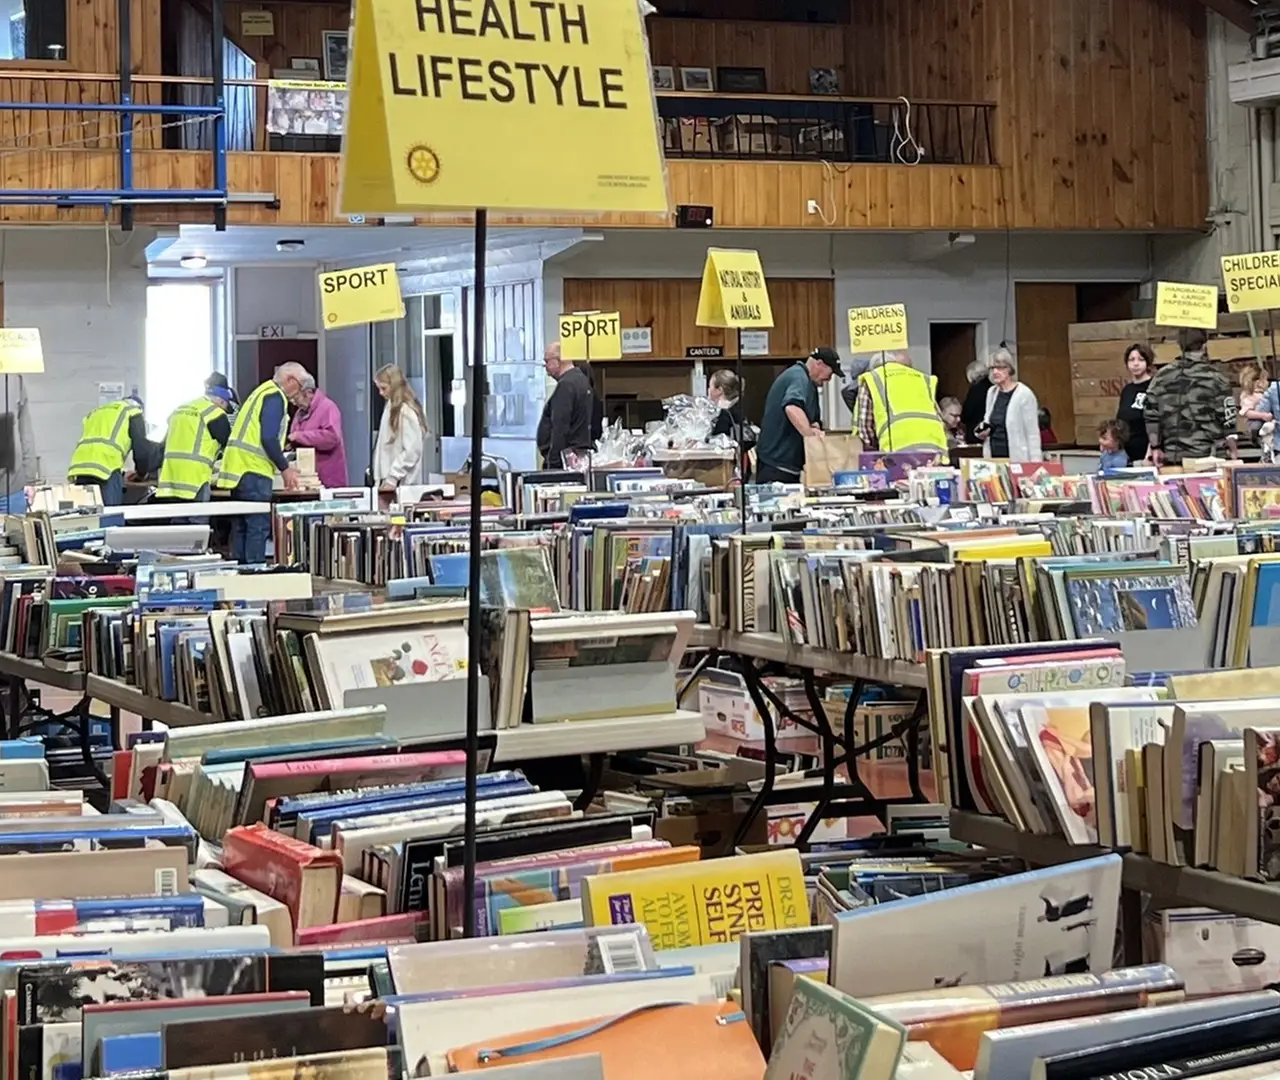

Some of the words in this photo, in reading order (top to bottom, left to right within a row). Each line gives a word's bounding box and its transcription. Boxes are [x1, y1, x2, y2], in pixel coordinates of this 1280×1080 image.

[389, 52, 628, 110] LIFESTYLE
[324, 269, 388, 293] SPORT
[742, 271, 762, 289] HISTORY
[742, 291, 748, 301] &
[730, 305, 762, 320] ANIMALS
[850, 307, 904, 321] CHILDRENS
[561, 318, 618, 338] SPORT
[854, 322, 902, 336] SPECIALS
[689, 347, 720, 356] CANTEEN
[777, 876, 793, 901] DR.
[641, 897, 659, 923] ALL
[658, 892, 672, 918] TO
[742, 880, 765, 932] PRE
[781, 904, 797, 929] SU
[674, 906, 691, 949] WOM
